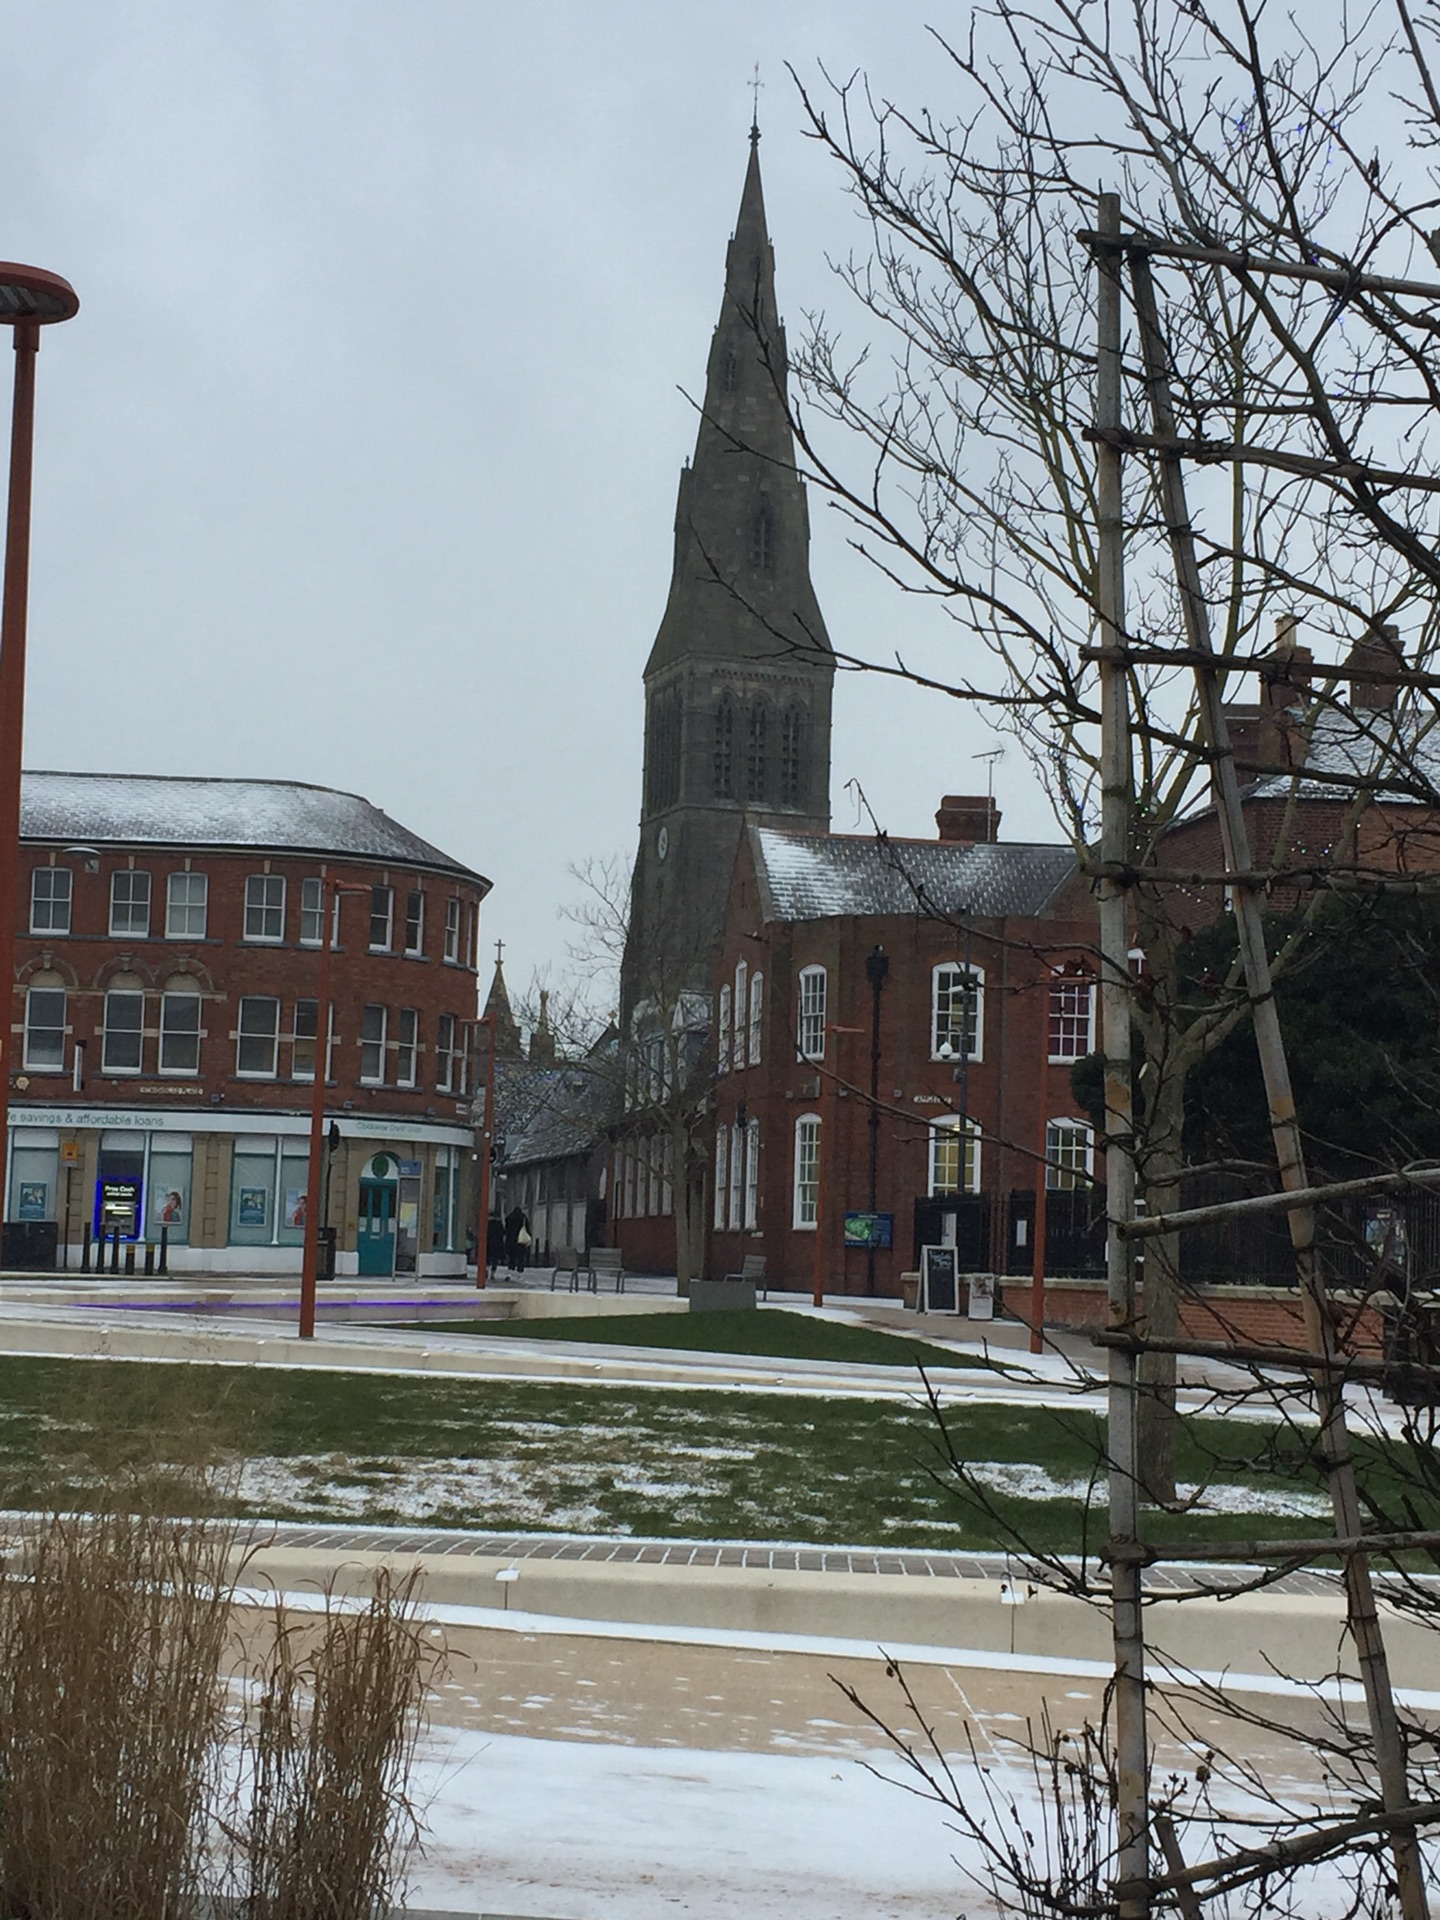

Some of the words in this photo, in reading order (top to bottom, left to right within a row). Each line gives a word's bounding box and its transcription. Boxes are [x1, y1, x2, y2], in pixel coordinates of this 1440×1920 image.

[20, 1112, 62, 1124] savings
[65, 1113, 74, 1123] &
[76, 1113, 131, 1125] affordable
[134, 1115, 164, 1126] loans
